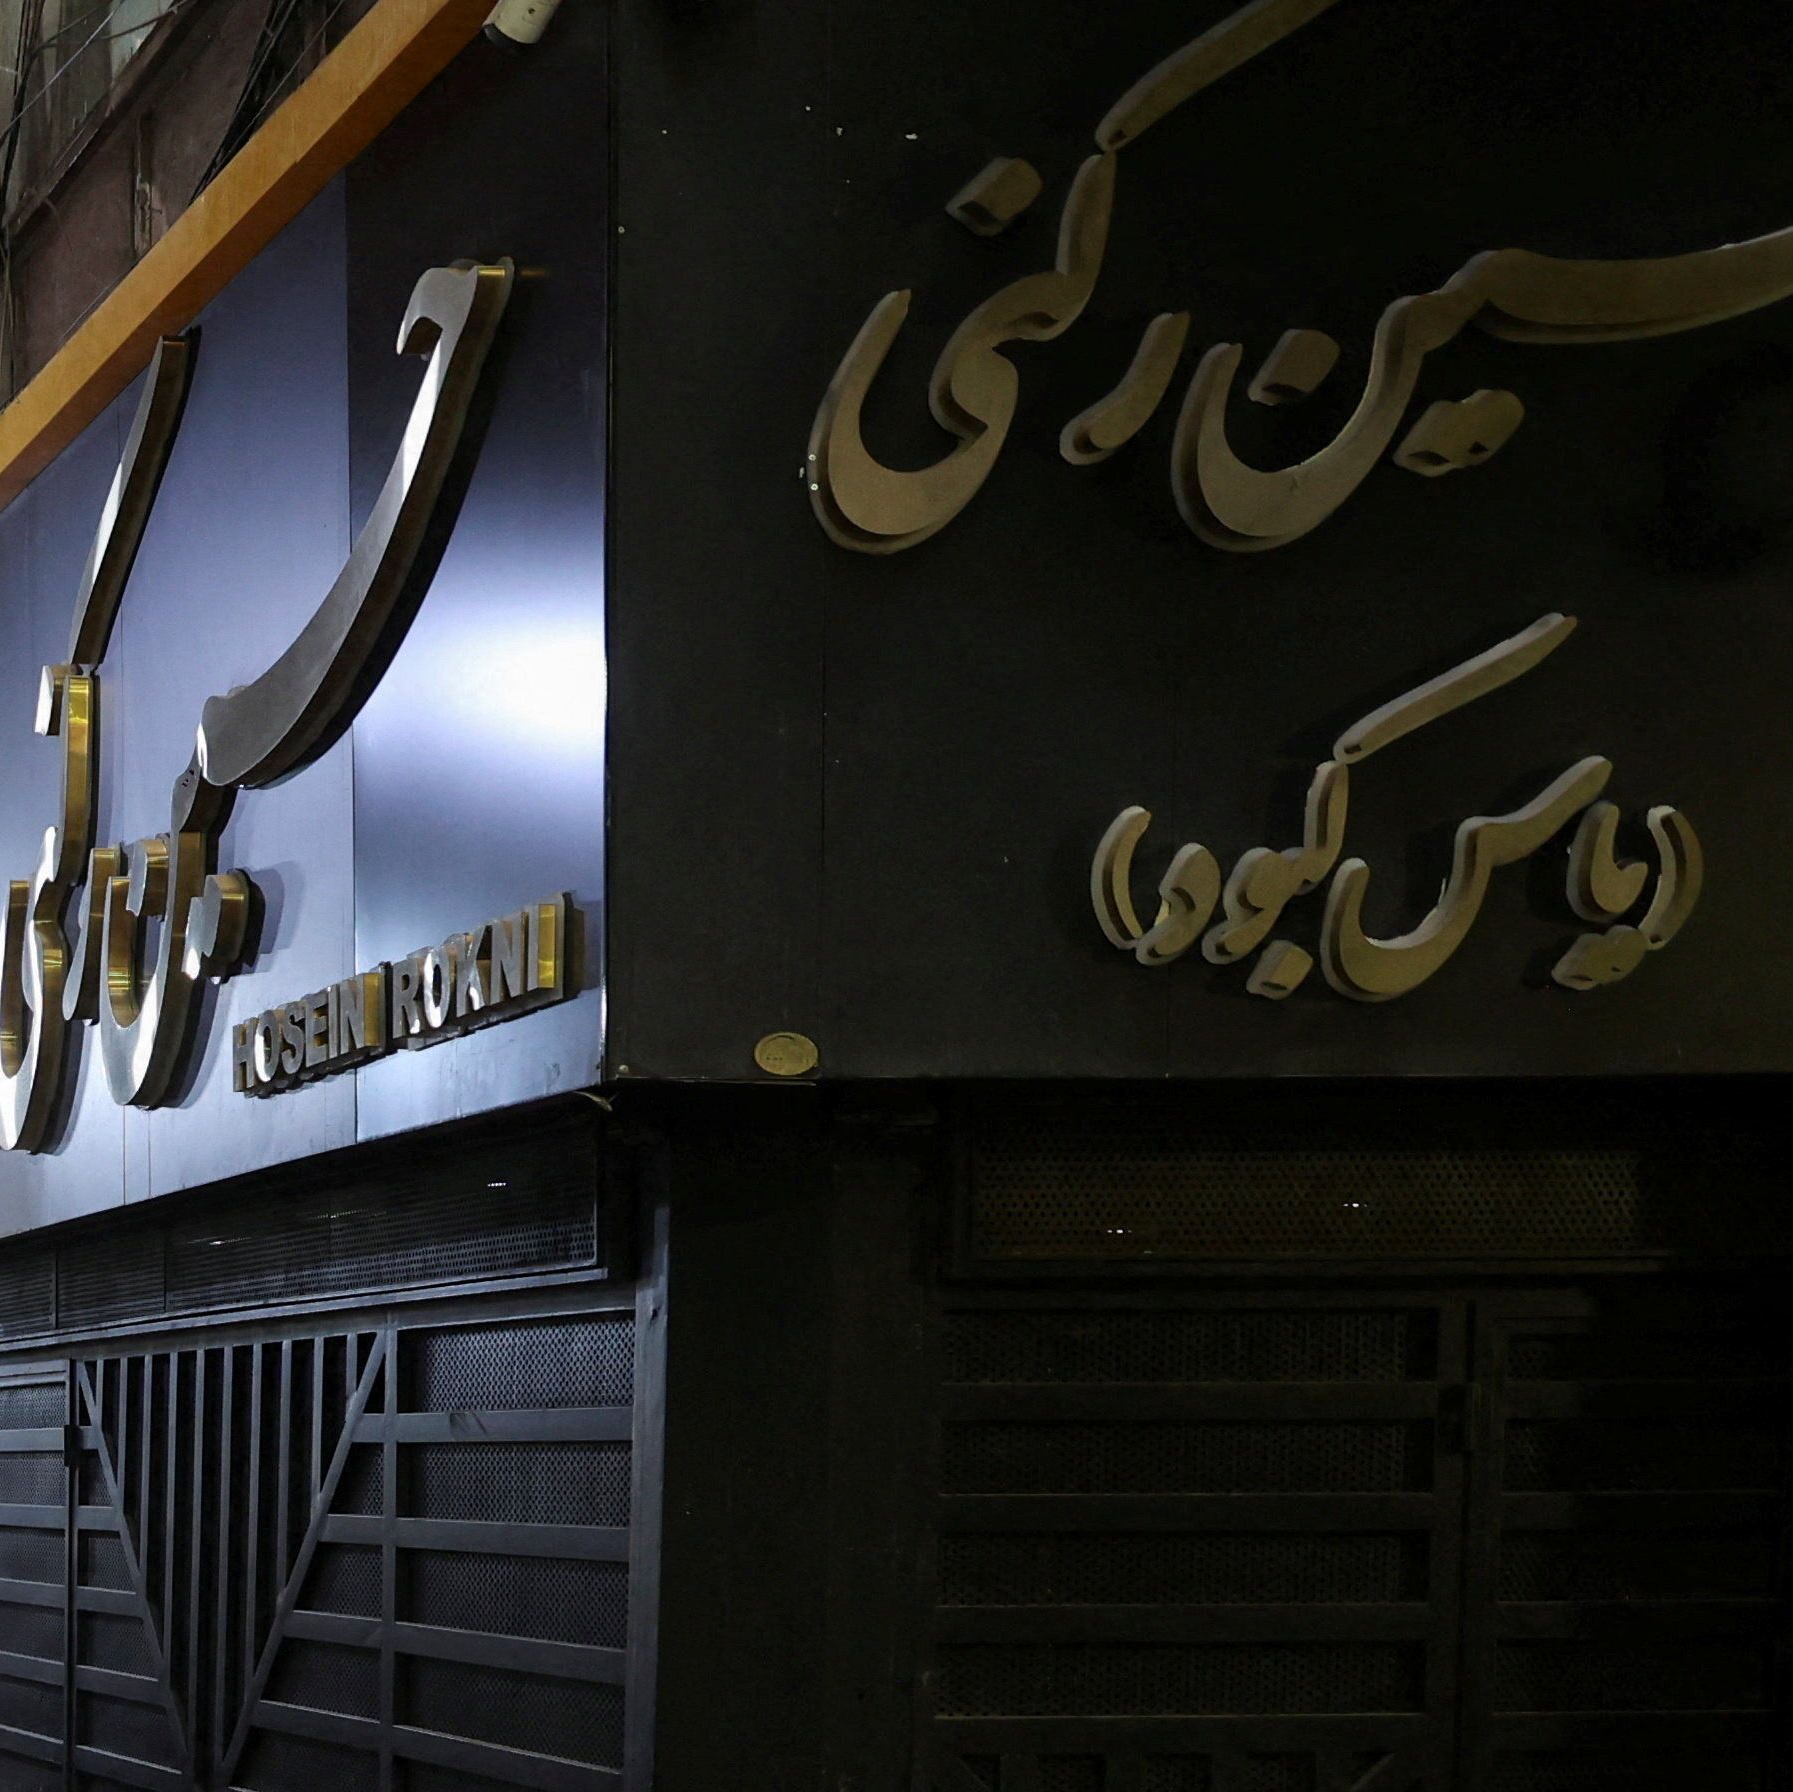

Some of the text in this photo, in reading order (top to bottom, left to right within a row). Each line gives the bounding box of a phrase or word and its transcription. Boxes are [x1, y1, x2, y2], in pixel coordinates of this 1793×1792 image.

[1172, 225, 1793, 552] سین
[232, 892, 573, 1096] HOSEIN ROKNI
